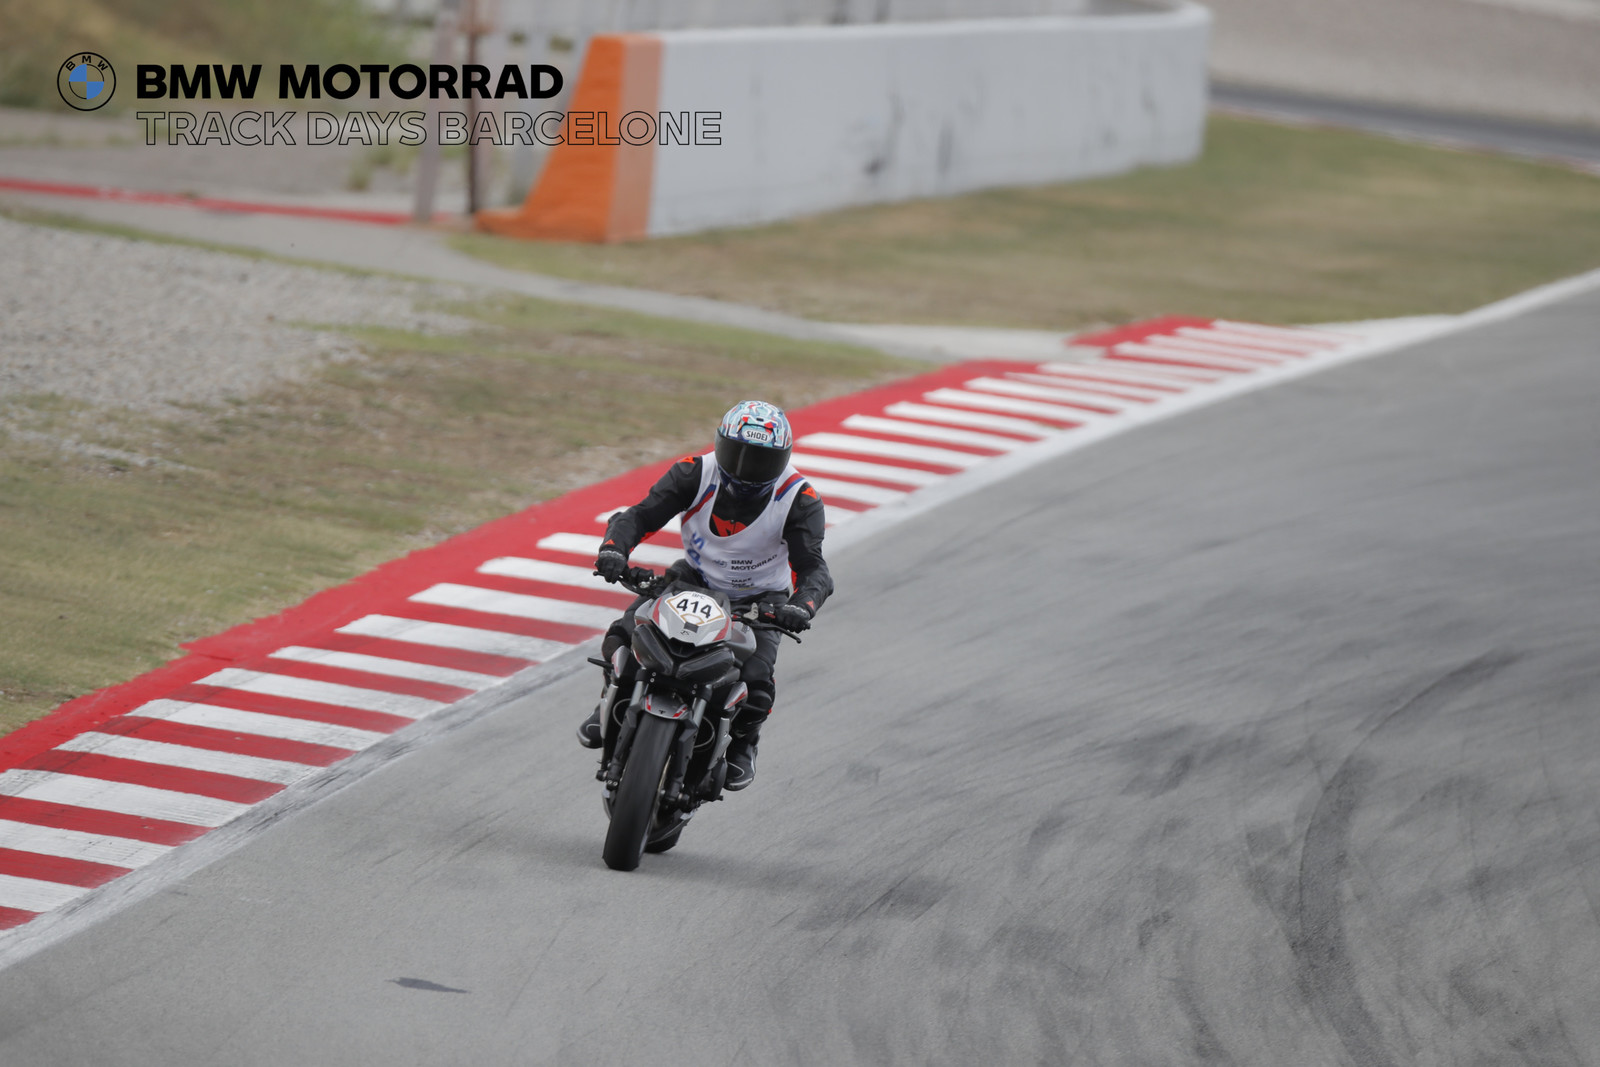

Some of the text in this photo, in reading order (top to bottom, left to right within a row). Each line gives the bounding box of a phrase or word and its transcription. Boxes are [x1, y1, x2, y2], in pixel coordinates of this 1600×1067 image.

[746, 430, 768, 441] SHOEI
[731, 553, 778, 571] MOTORRAD
[676, 598, 712, 619] 414
